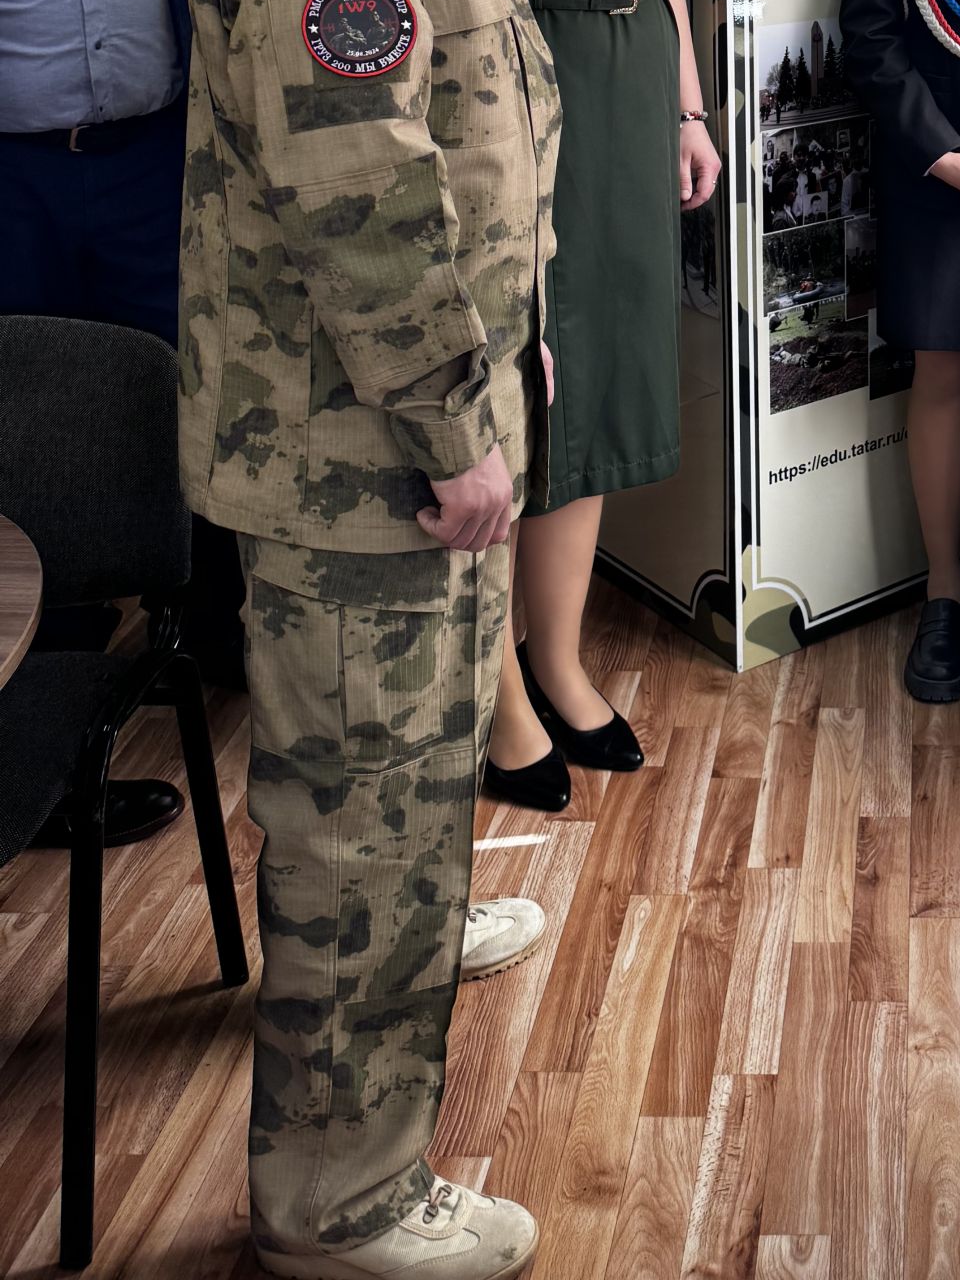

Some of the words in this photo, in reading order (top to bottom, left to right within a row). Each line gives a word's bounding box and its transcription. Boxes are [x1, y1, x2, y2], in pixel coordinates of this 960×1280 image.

[310, 38, 332, 62] ГРУЗ
[331, 59, 351, 72] 200
[354, 61, 377, 73] МЫ
[377, 33, 411, 68] ВМЕСТЕ
